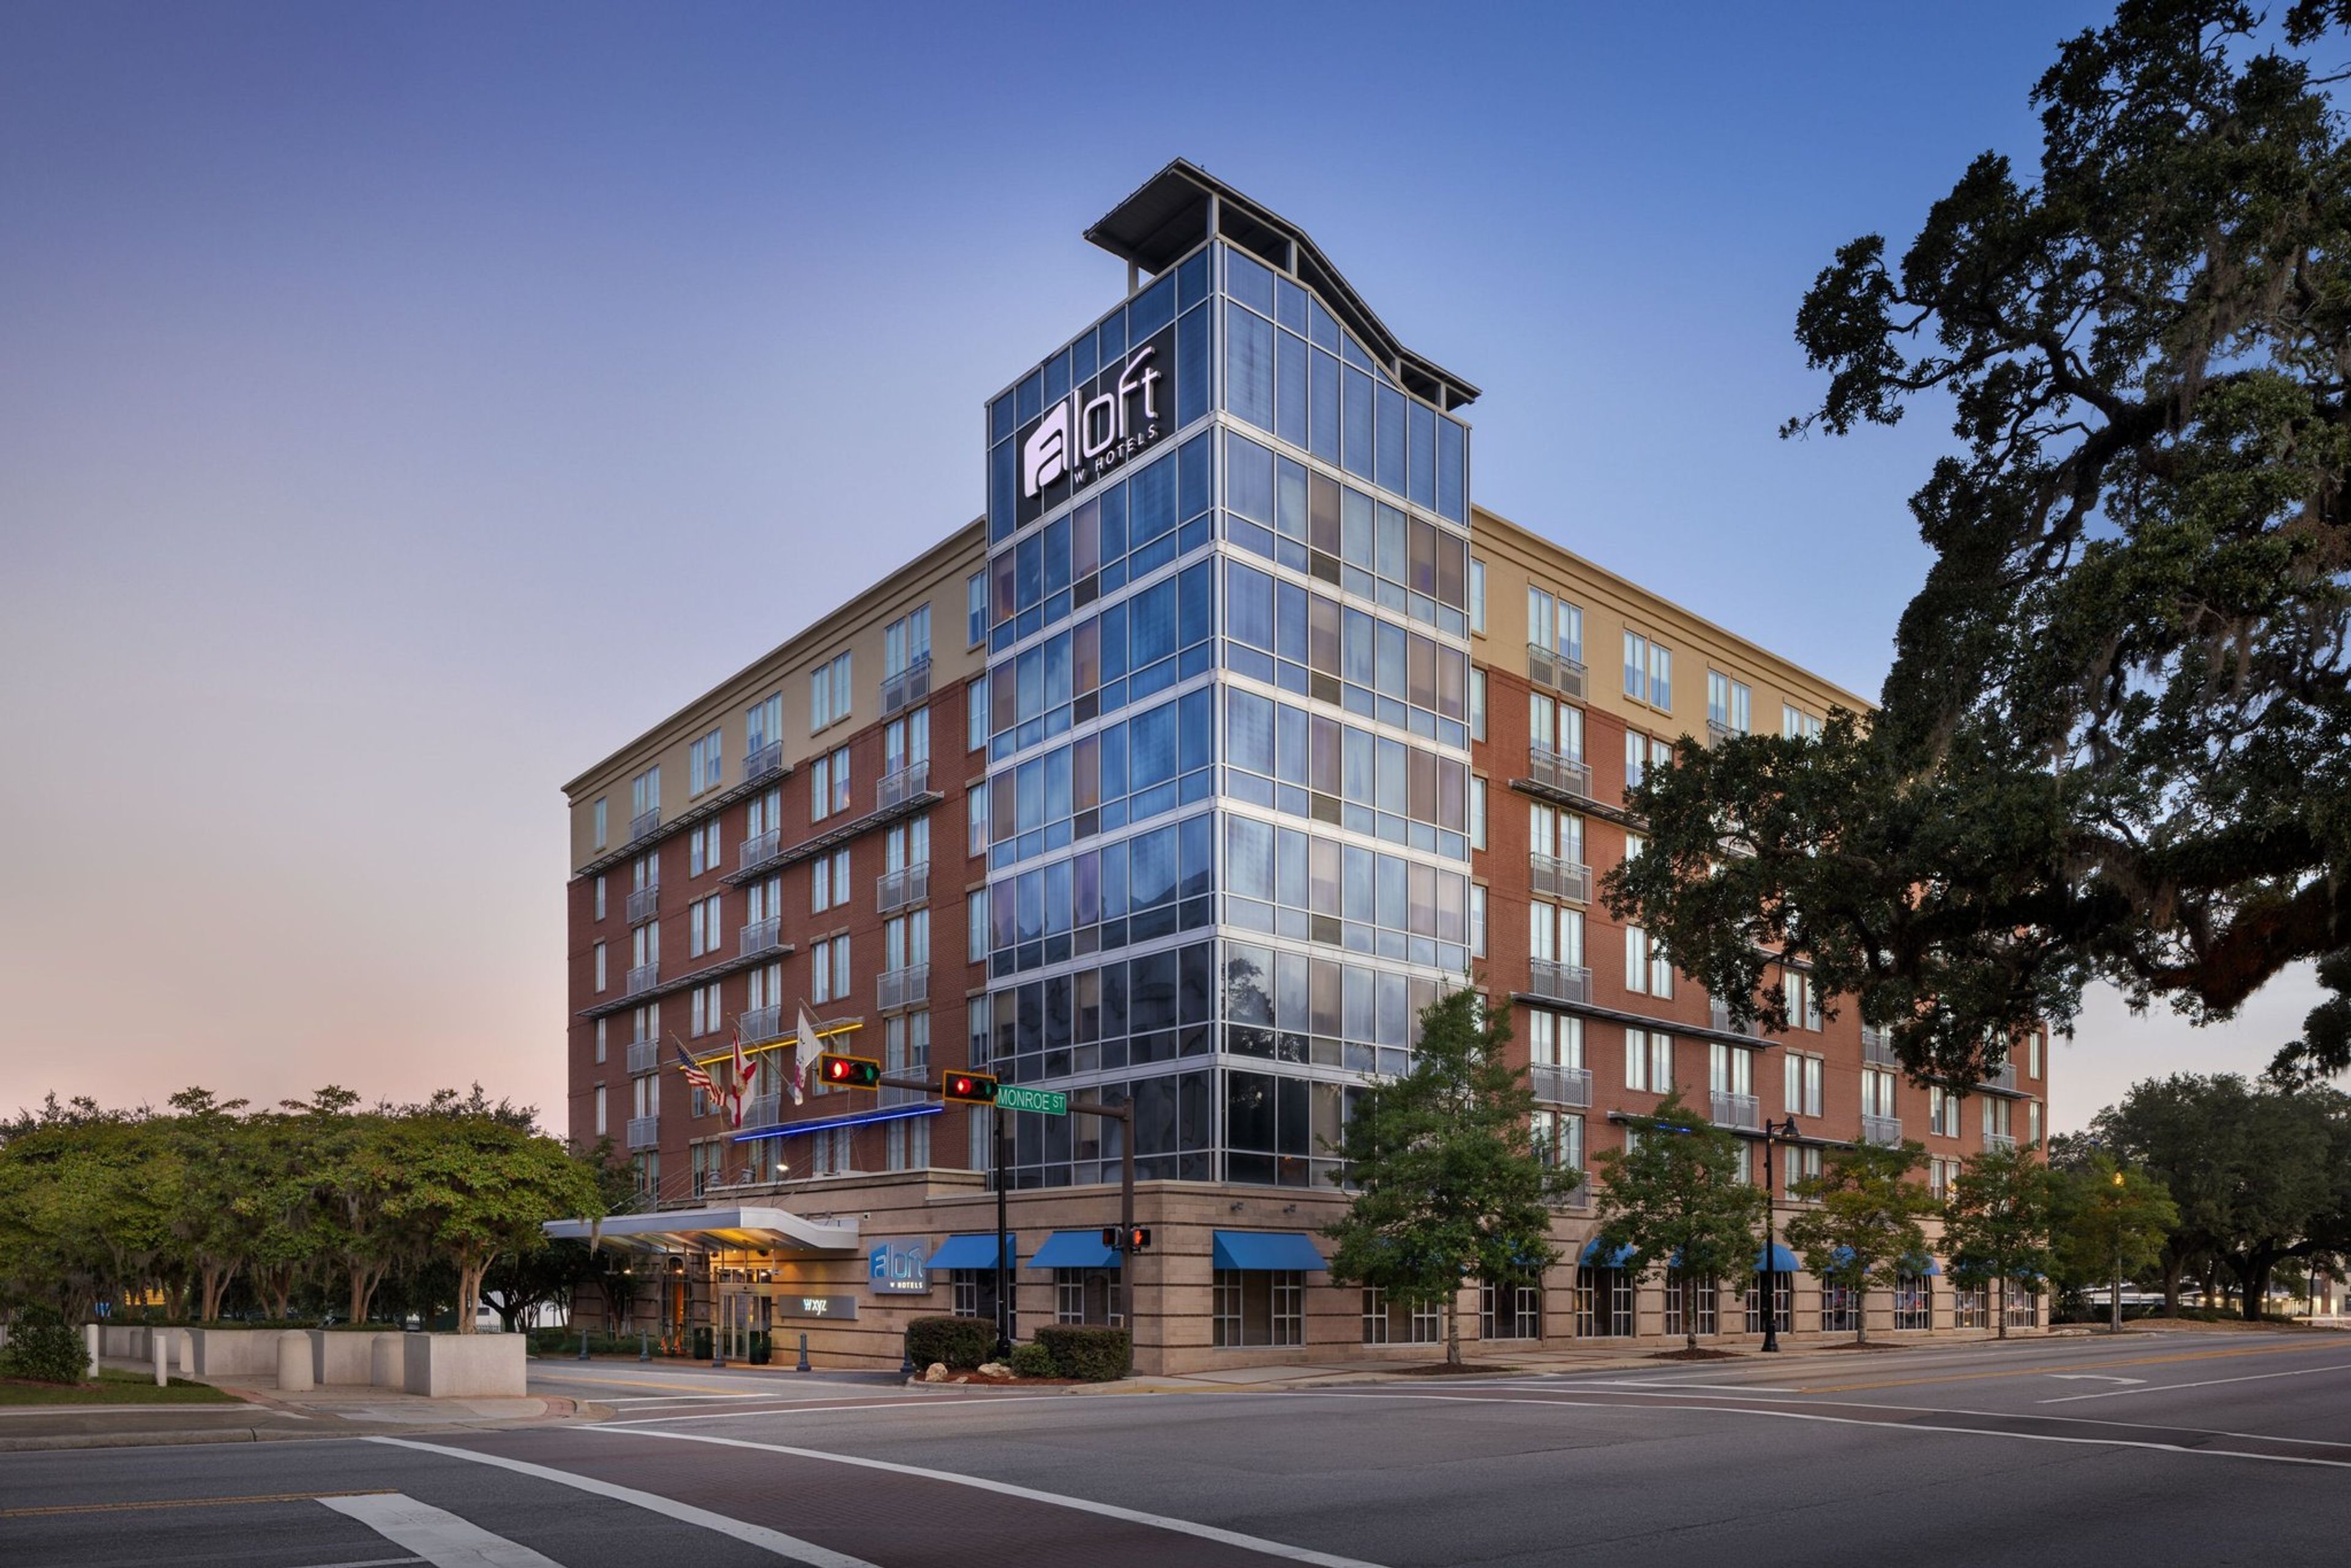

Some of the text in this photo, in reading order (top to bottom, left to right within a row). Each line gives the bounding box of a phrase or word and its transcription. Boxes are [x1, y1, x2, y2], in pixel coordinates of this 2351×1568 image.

[1024, 346, 1160, 497] aloft
[1074, 424, 1158, 484] W HOTELS
[998, 1087, 1064, 1110] MONROE ST
